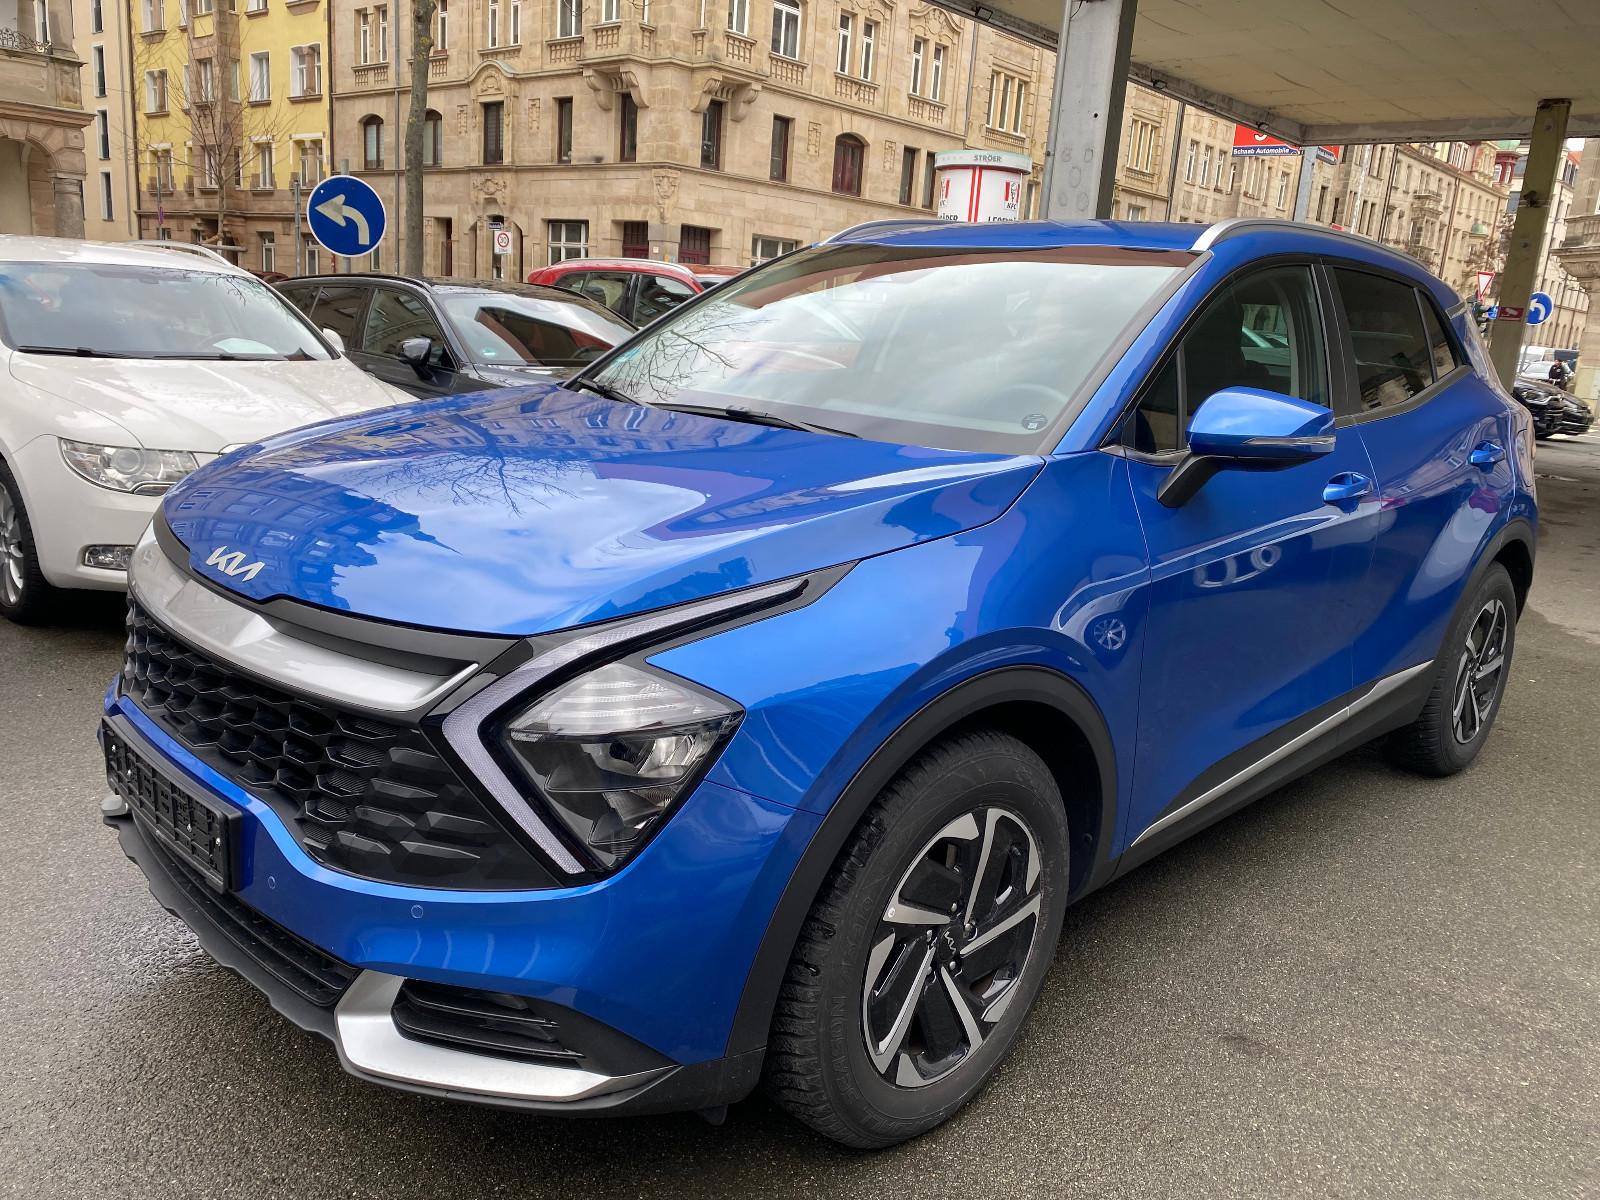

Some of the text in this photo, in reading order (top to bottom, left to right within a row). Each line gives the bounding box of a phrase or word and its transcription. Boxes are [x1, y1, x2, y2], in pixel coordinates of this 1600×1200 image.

[973, 154, 1002, 162] STRÖER
[1006, 202, 1017, 210] KFC
[205, 545, 266, 583] KIA
